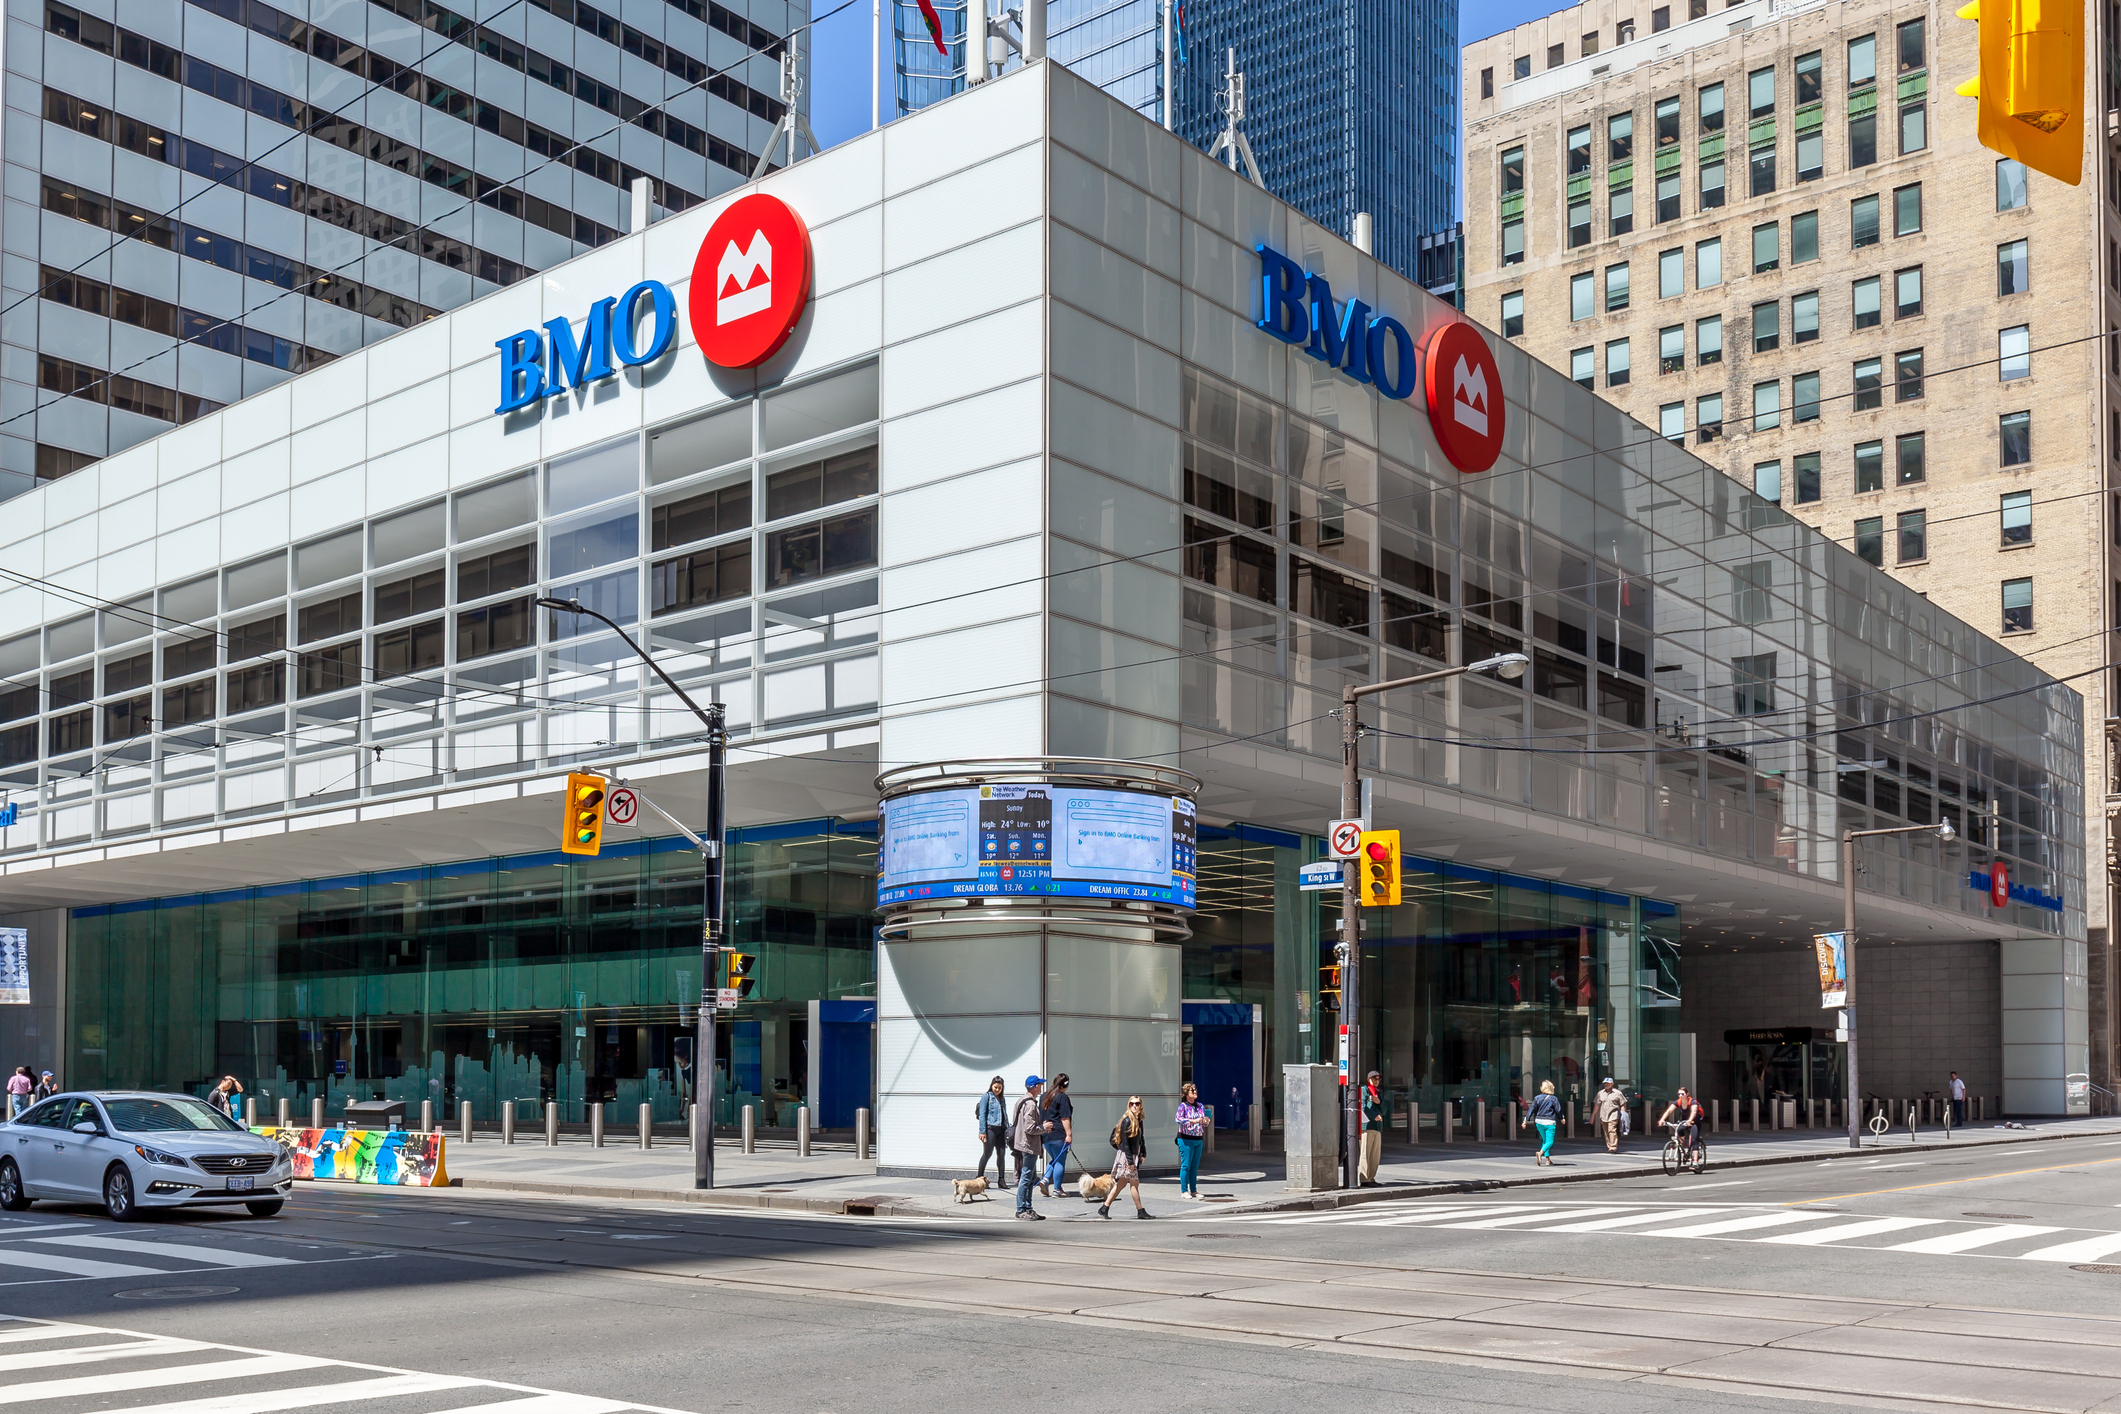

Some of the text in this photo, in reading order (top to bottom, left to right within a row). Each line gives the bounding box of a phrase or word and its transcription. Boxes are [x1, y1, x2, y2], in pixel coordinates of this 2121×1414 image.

[1255, 243, 1417, 400] BMO
[494, 279, 677, 415] BMO
[1027, 790, 1045, 800] Today
[1006, 804, 1024, 813] Sunny
[981, 819, 1050, 831] High: 24° Low: 10°
[929, 831, 948, 839] Banking
[1078, 829, 1090, 838] Sign
[1104, 830, 1116, 838] BMO
[1117, 832, 1132, 840] Online
[1133, 833, 1151, 842] Banking
[1008, 852, 1020, 860] 12°
[1033, 852, 1045, 860] 11°
[980, 870, 999, 878] BMO
[1018, 869, 1050, 878] 12:51 PM
[1308, 874, 1322, 883] King
[953, 883, 1023, 893] DREAM GLOBA 13.76
[1045, 883, 1061, 892] 0.21
[1089, 885, 1148, 897] DREAM OFFIC 23.84
[18, 932, 27, 986] OPPORTUNITY
[1817, 938, 1828, 975] DISCOVER
[1767, 1031, 1784, 1039] ROSEN
